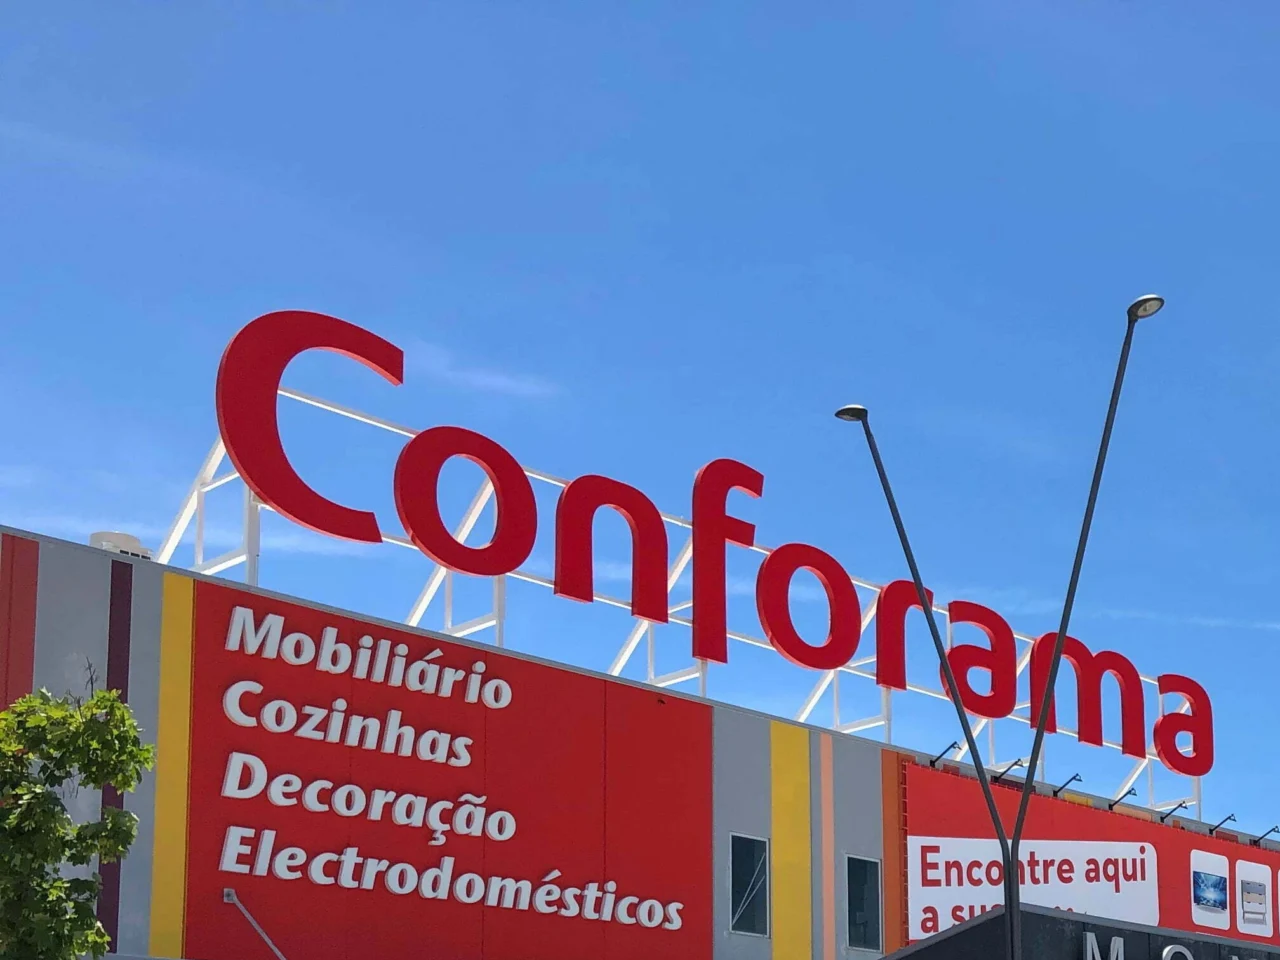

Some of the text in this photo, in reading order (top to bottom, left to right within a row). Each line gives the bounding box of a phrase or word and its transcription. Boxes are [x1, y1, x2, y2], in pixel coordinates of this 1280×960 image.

[216, 310, 1215, 777] Conforama
[225, 605, 513, 710] Mobiliário
[222, 680, 474, 767] Cozinhas
[220, 751, 516, 846] Decoração
[218, 826, 685, 931] Electrodomésticos
[1084, 845, 1146, 893] aqui
[920, 905, 939, 934] a
